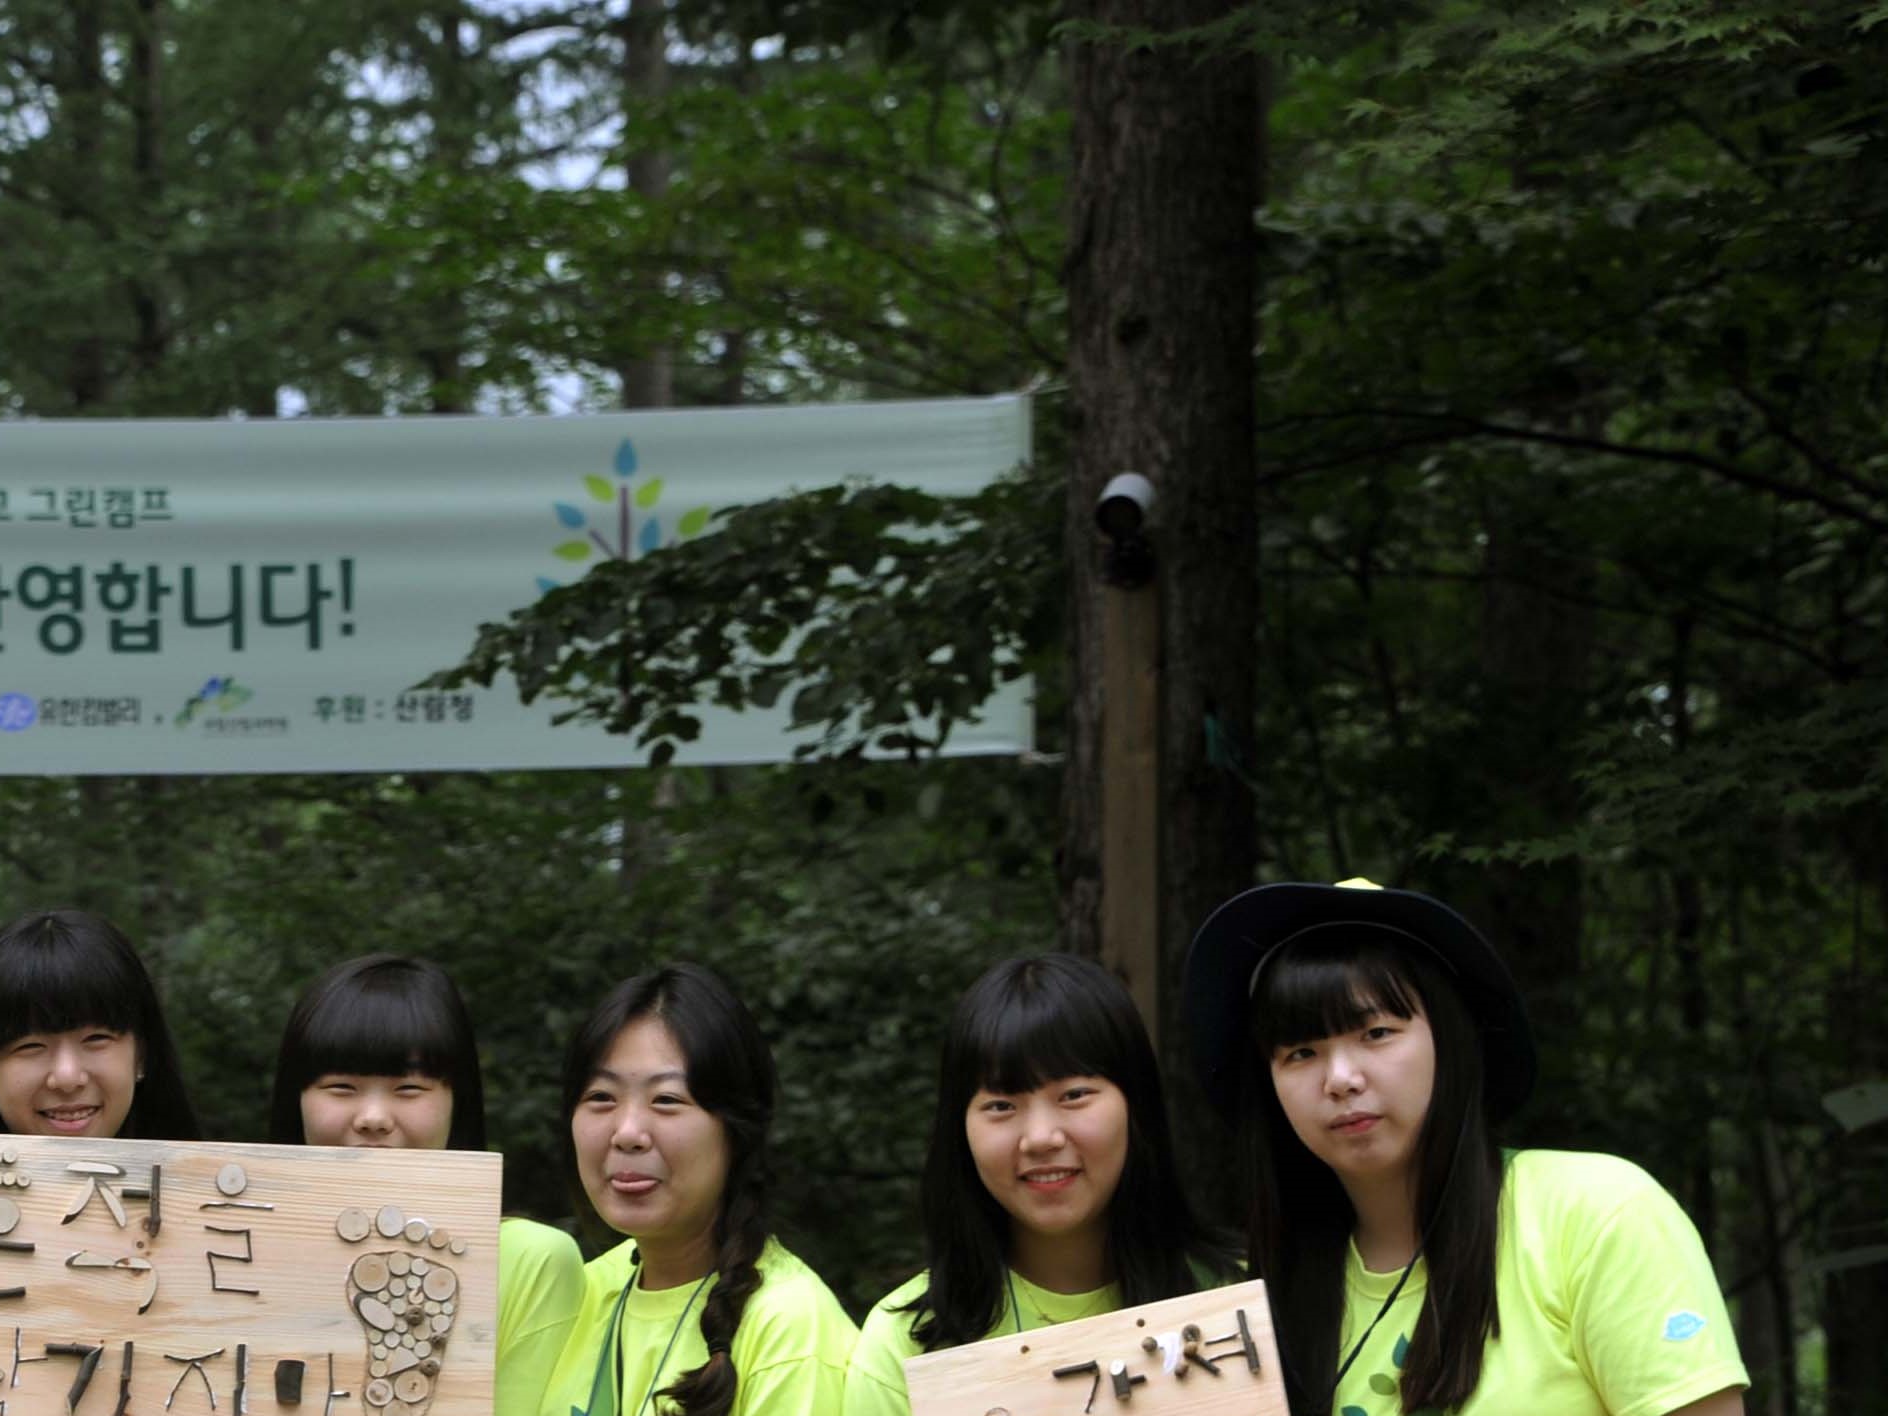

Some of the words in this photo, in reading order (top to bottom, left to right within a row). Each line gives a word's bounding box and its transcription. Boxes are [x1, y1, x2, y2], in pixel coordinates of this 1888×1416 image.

[26, 487, 174, 529] 그린캠프
[314, 694, 368, 724] 후원
[393, 692, 476, 724] 산림청
